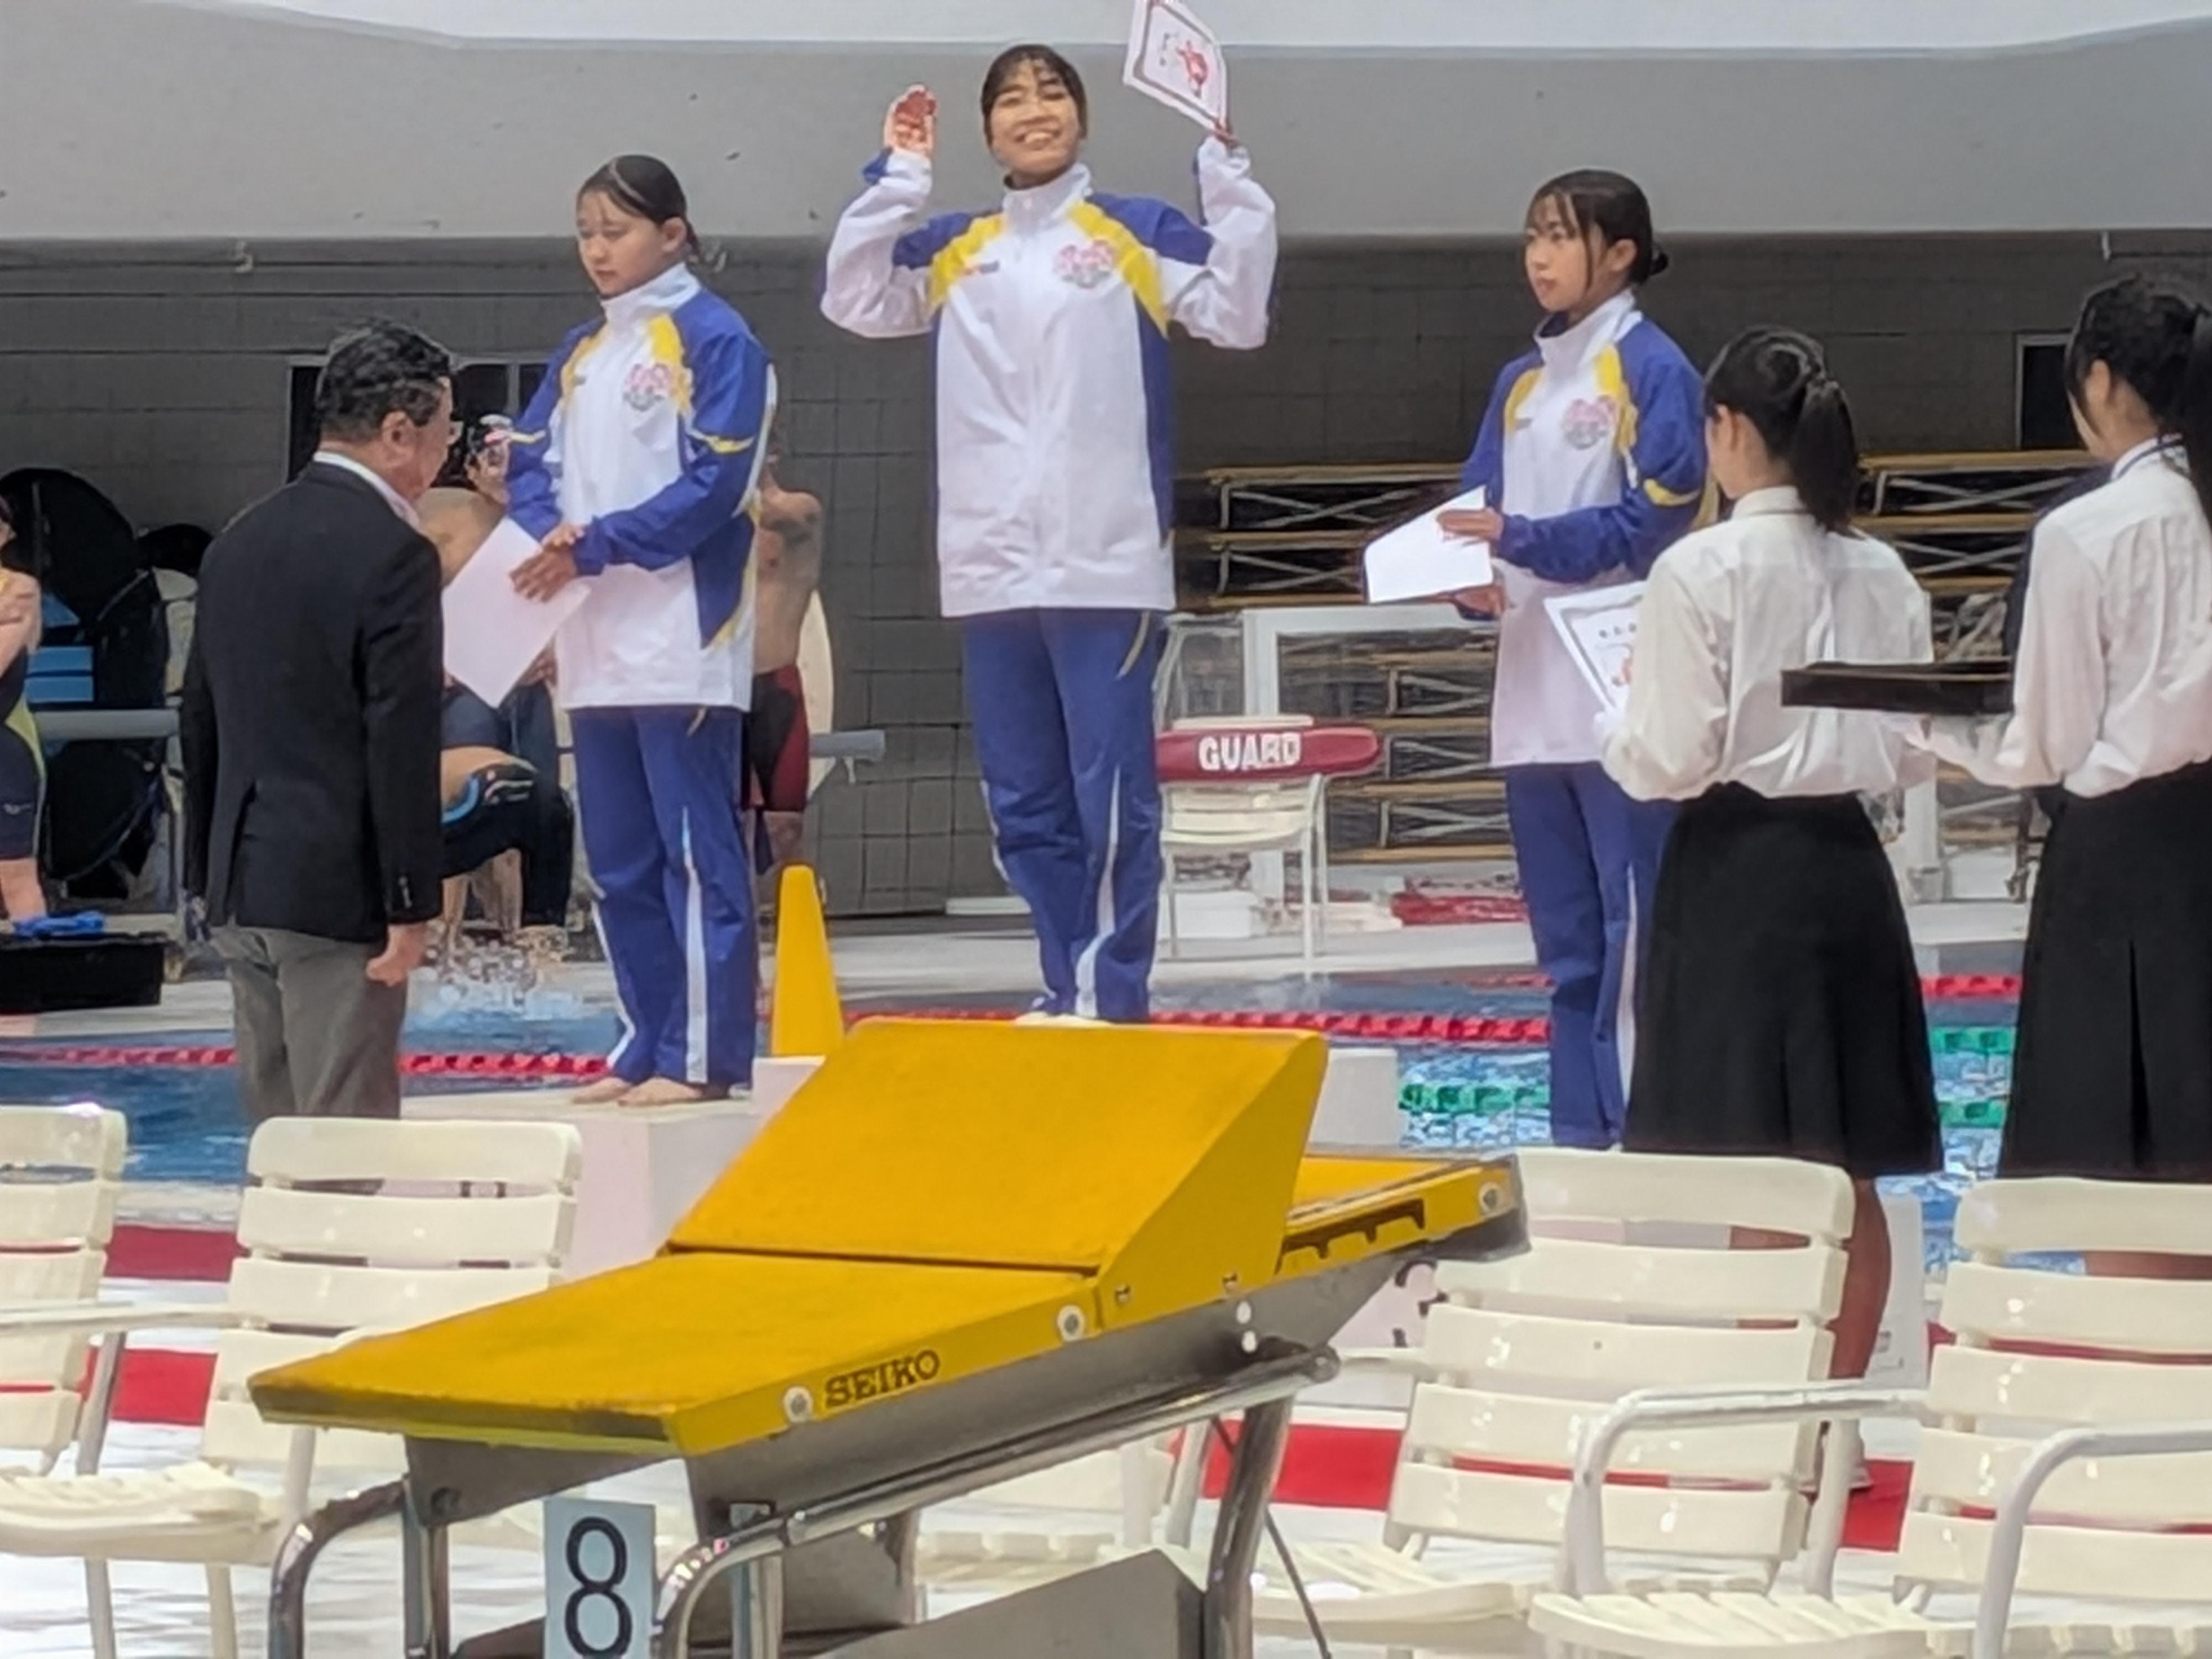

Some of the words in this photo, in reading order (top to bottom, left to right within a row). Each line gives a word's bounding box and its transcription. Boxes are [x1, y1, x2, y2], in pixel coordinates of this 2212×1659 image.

[1198, 732, 1301, 771] GUARD
[825, 1349, 940, 1408] SEIKO
[565, 1516, 633, 1659] 8
